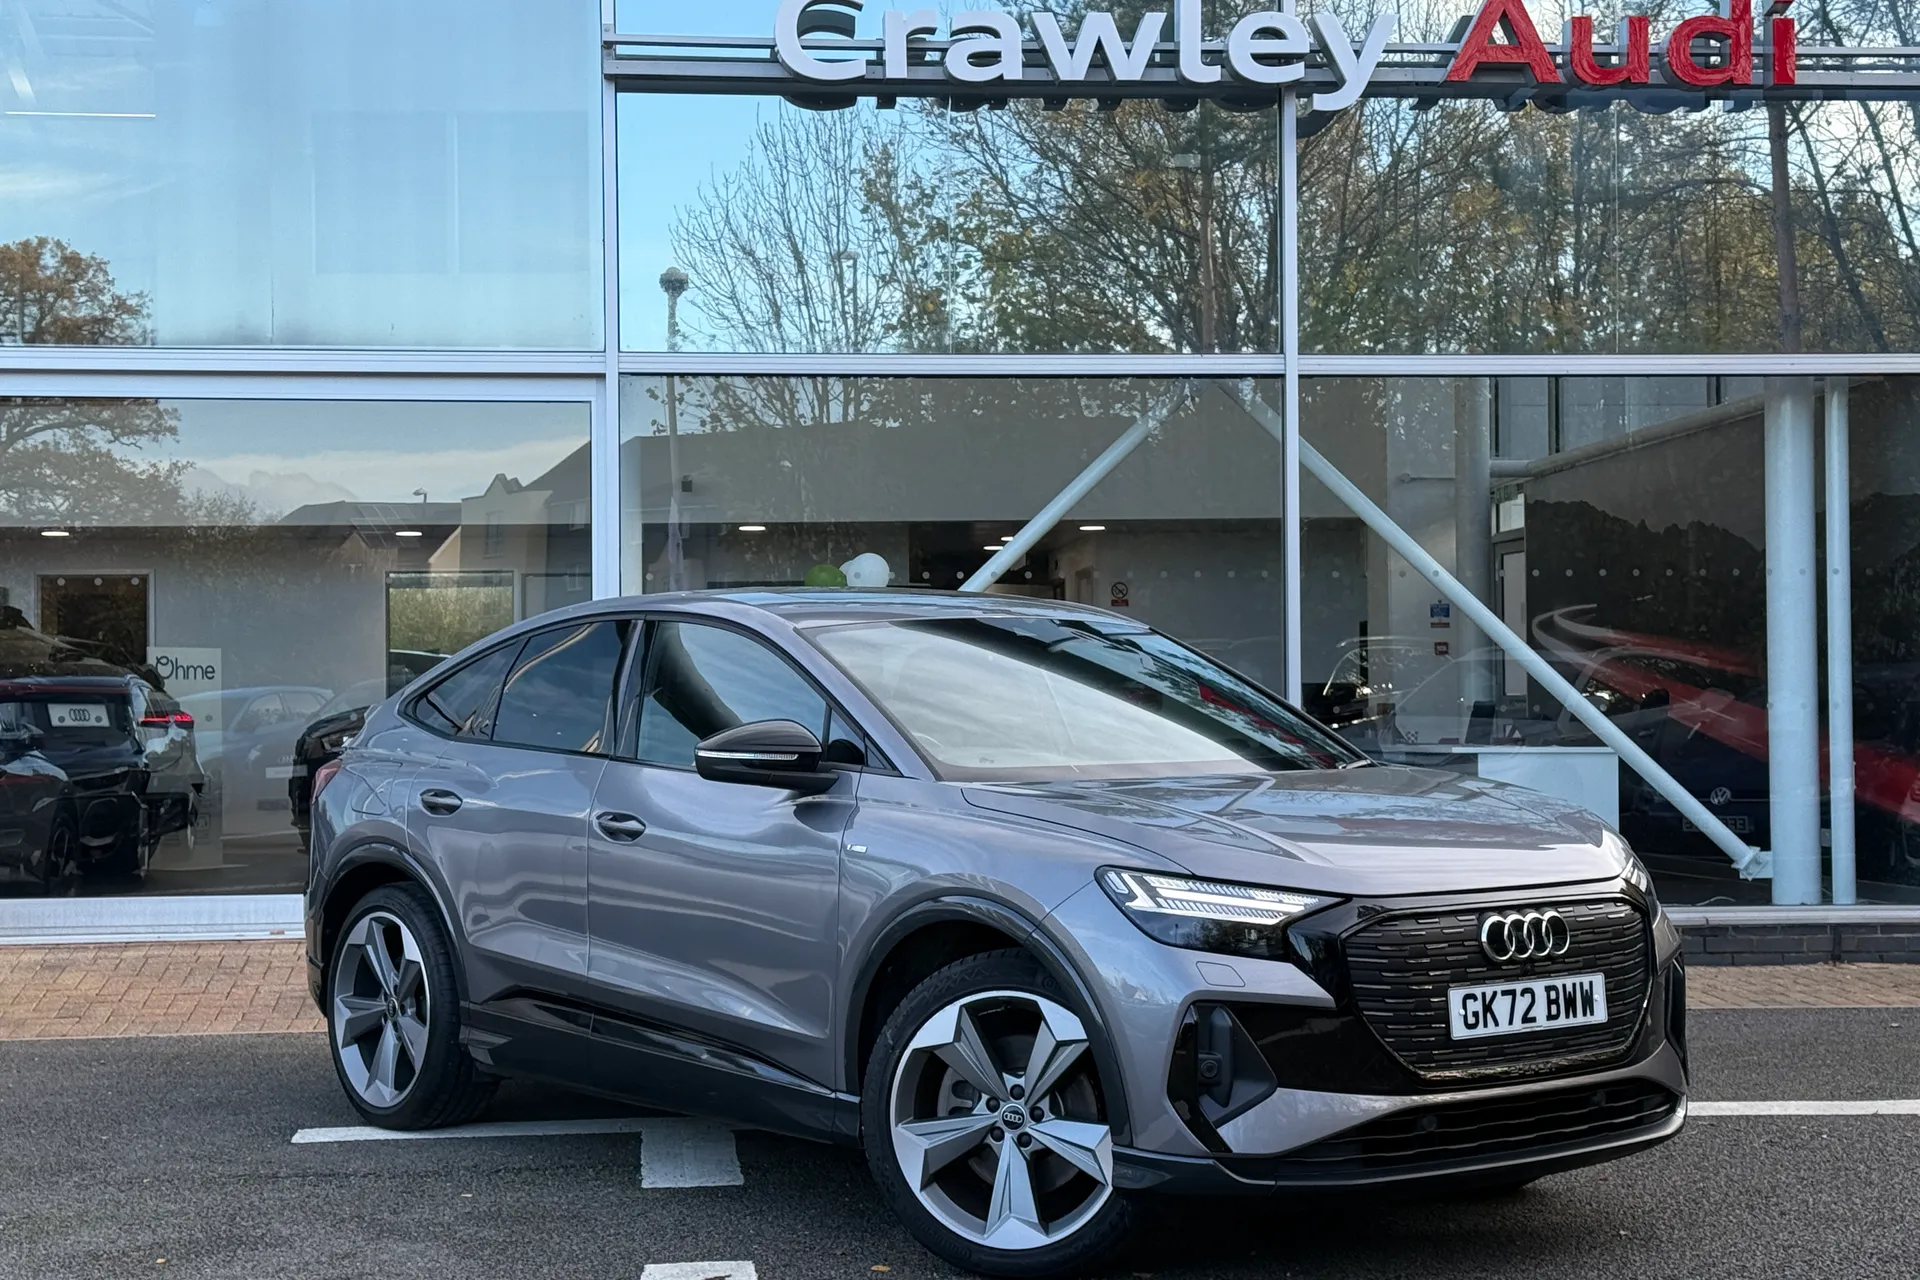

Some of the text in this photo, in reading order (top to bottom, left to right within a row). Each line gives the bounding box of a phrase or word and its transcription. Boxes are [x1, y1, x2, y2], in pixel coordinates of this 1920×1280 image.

[772, 0, 1796, 110] Crawley Audi
[156, 655, 216, 681] Ohme
[1461, 980, 1595, 1030] GK72 BWW
